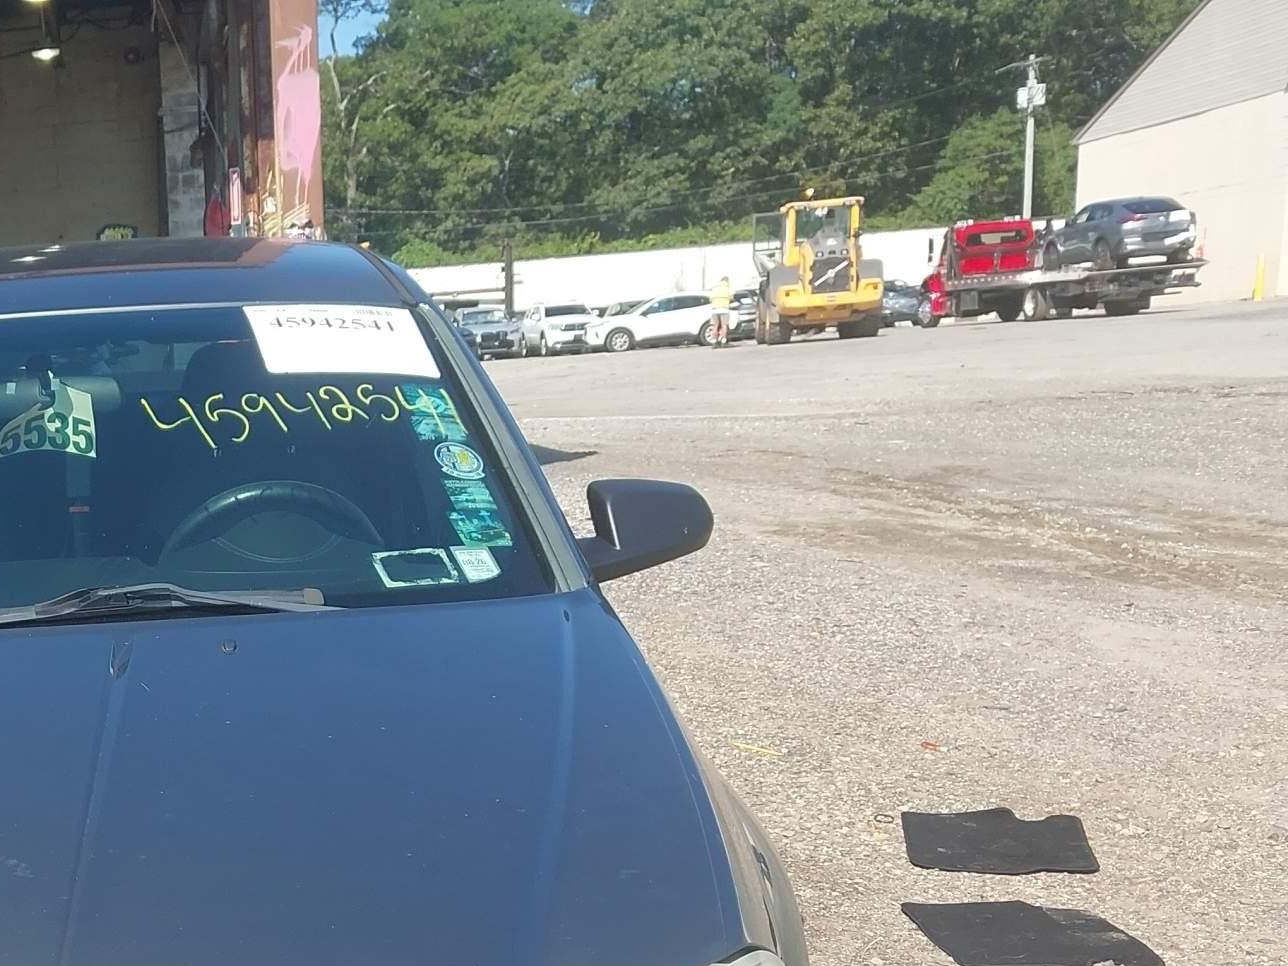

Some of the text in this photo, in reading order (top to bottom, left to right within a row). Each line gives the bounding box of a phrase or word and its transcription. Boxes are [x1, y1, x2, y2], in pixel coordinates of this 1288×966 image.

[268, 316, 399, 332] 45942541
[0, 412, 94, 455] 5535
[140, 383, 468, 449] 45942541
